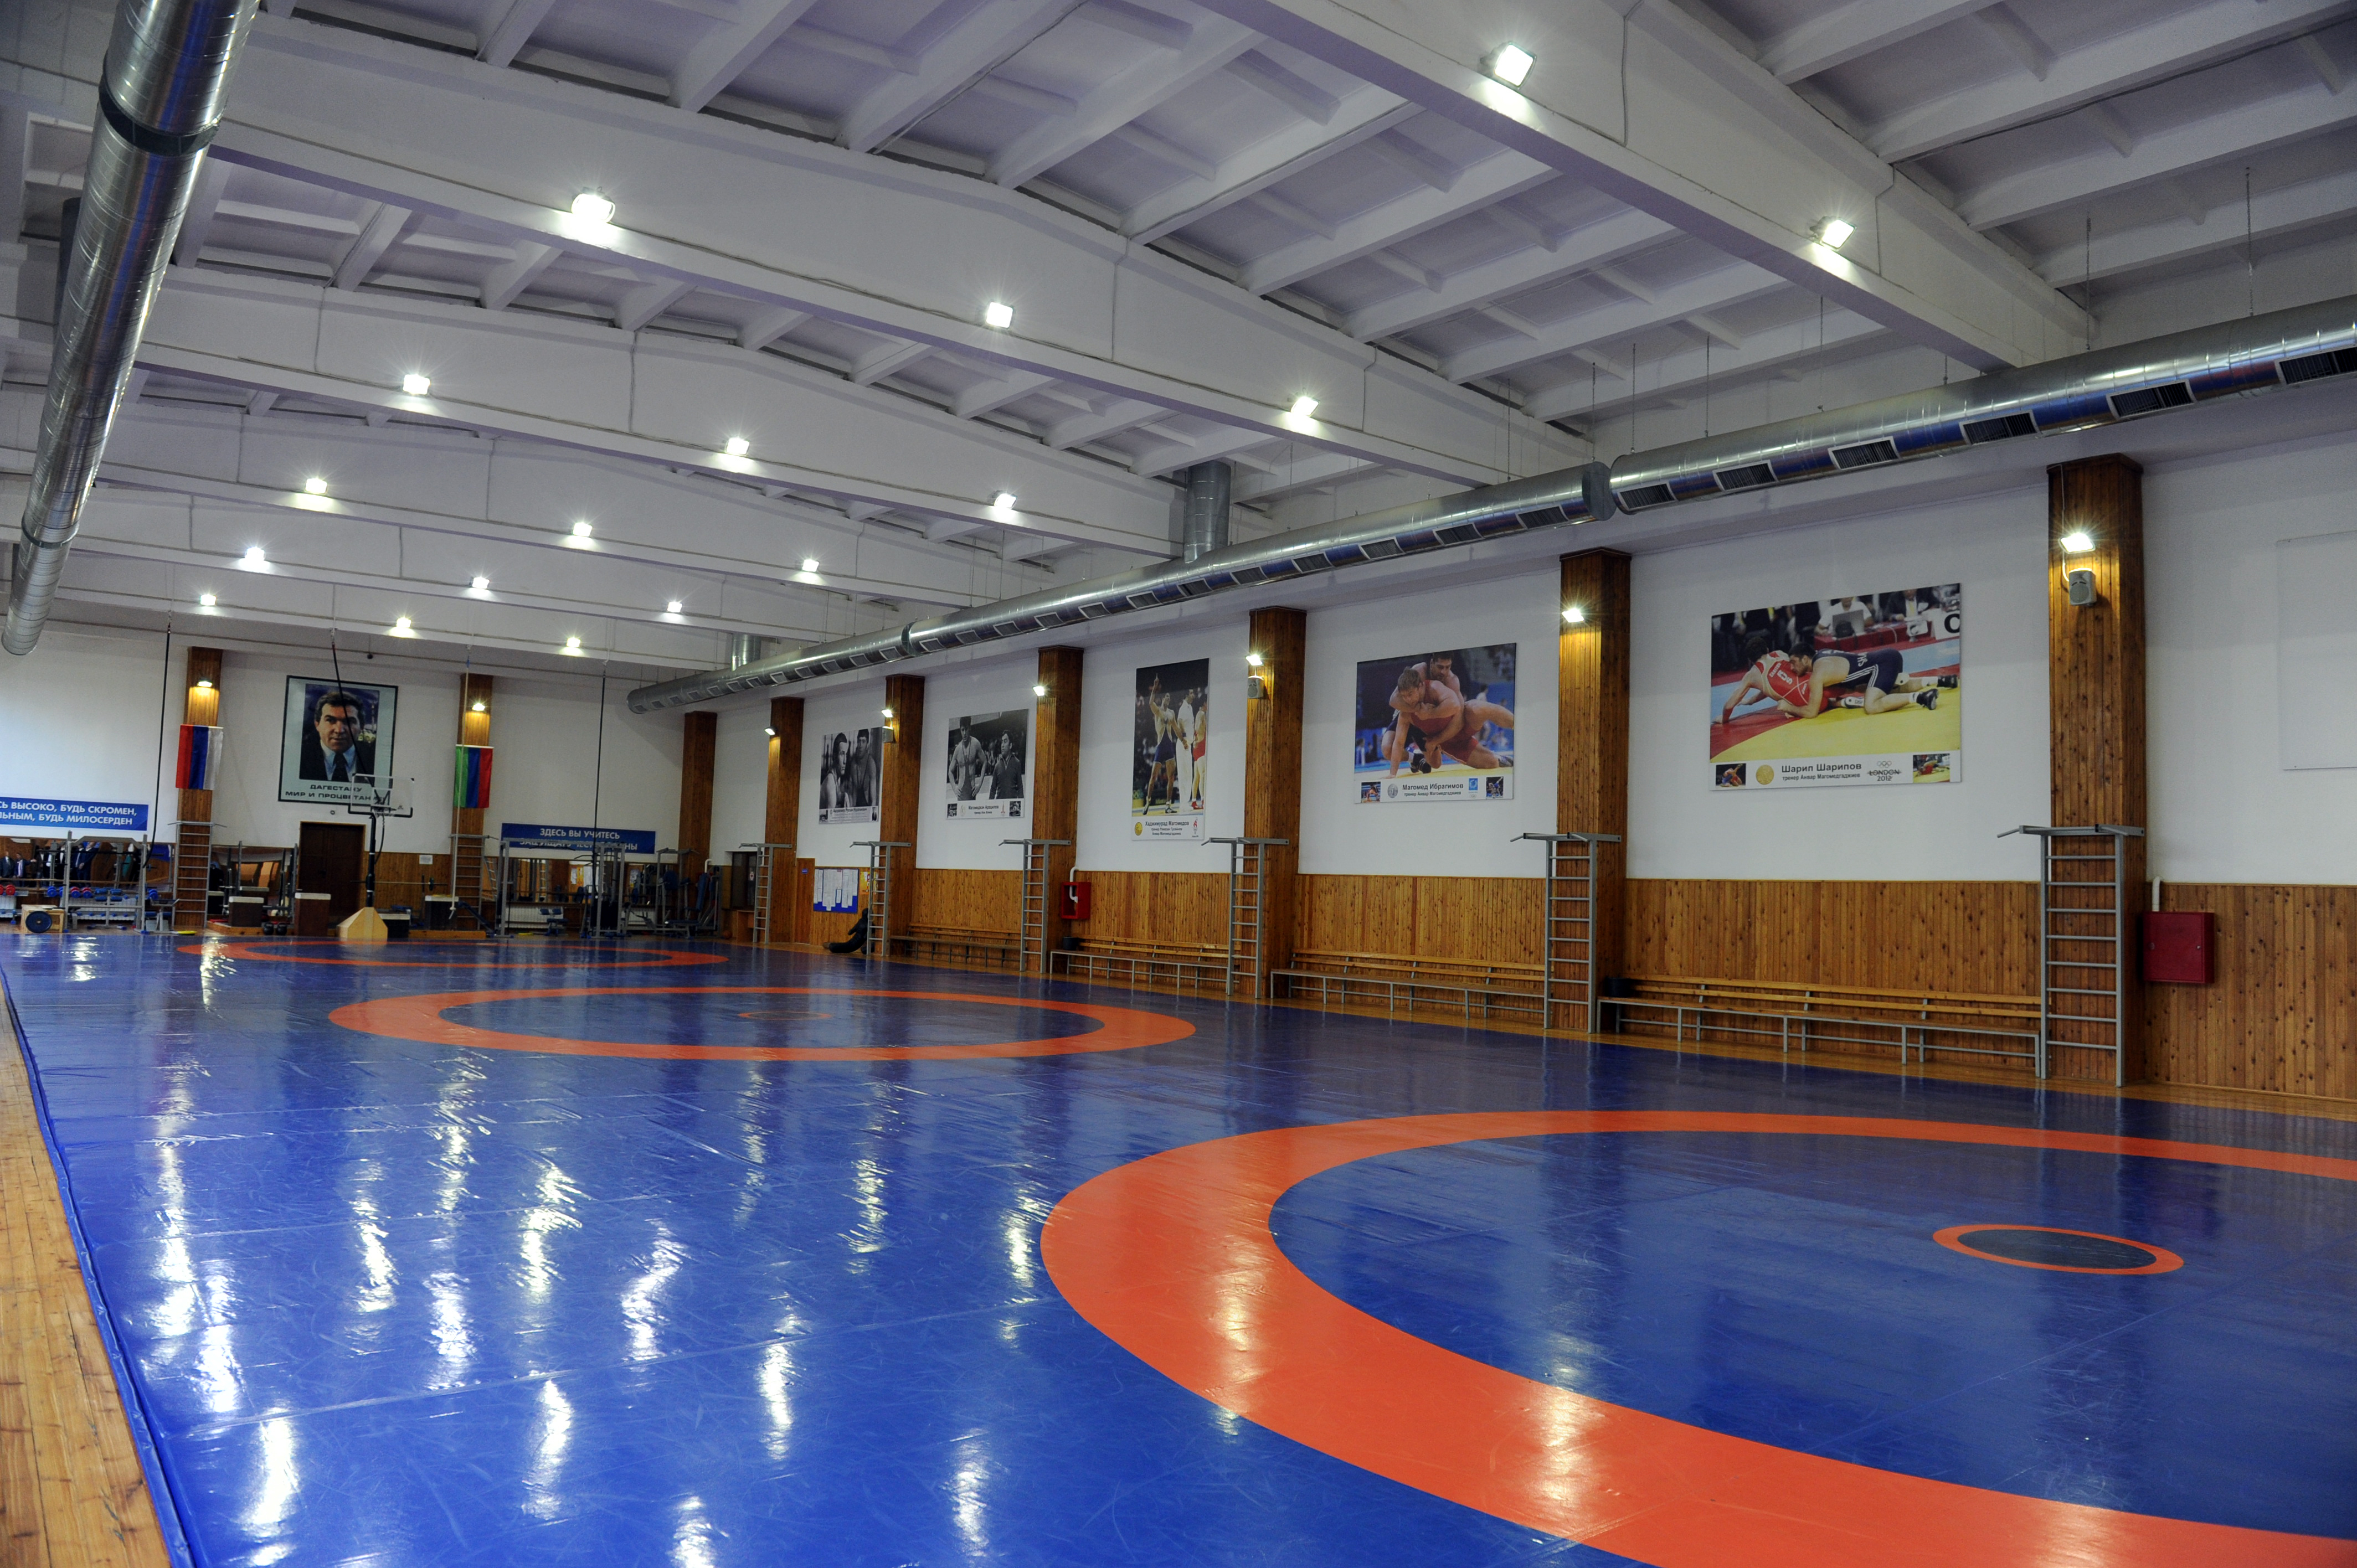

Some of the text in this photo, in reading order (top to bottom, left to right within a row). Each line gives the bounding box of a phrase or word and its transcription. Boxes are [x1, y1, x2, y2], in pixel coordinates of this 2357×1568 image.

[1782, 764, 1861, 773] Шарип Шарипов
[11, 802, 58, 812] ВЫСОКО,
[60, 804, 85, 813] БУДЬ
[88, 806, 137, 817] СКРОМЕН,
[39, 814, 64, 823] БУДЬ
[66, 815, 132, 826] МИЛОСЕРДЕН
[540, 828, 567, 837] ЗДЕСЬ
[584, 831, 620, 839] УЧИТЕСЬ
